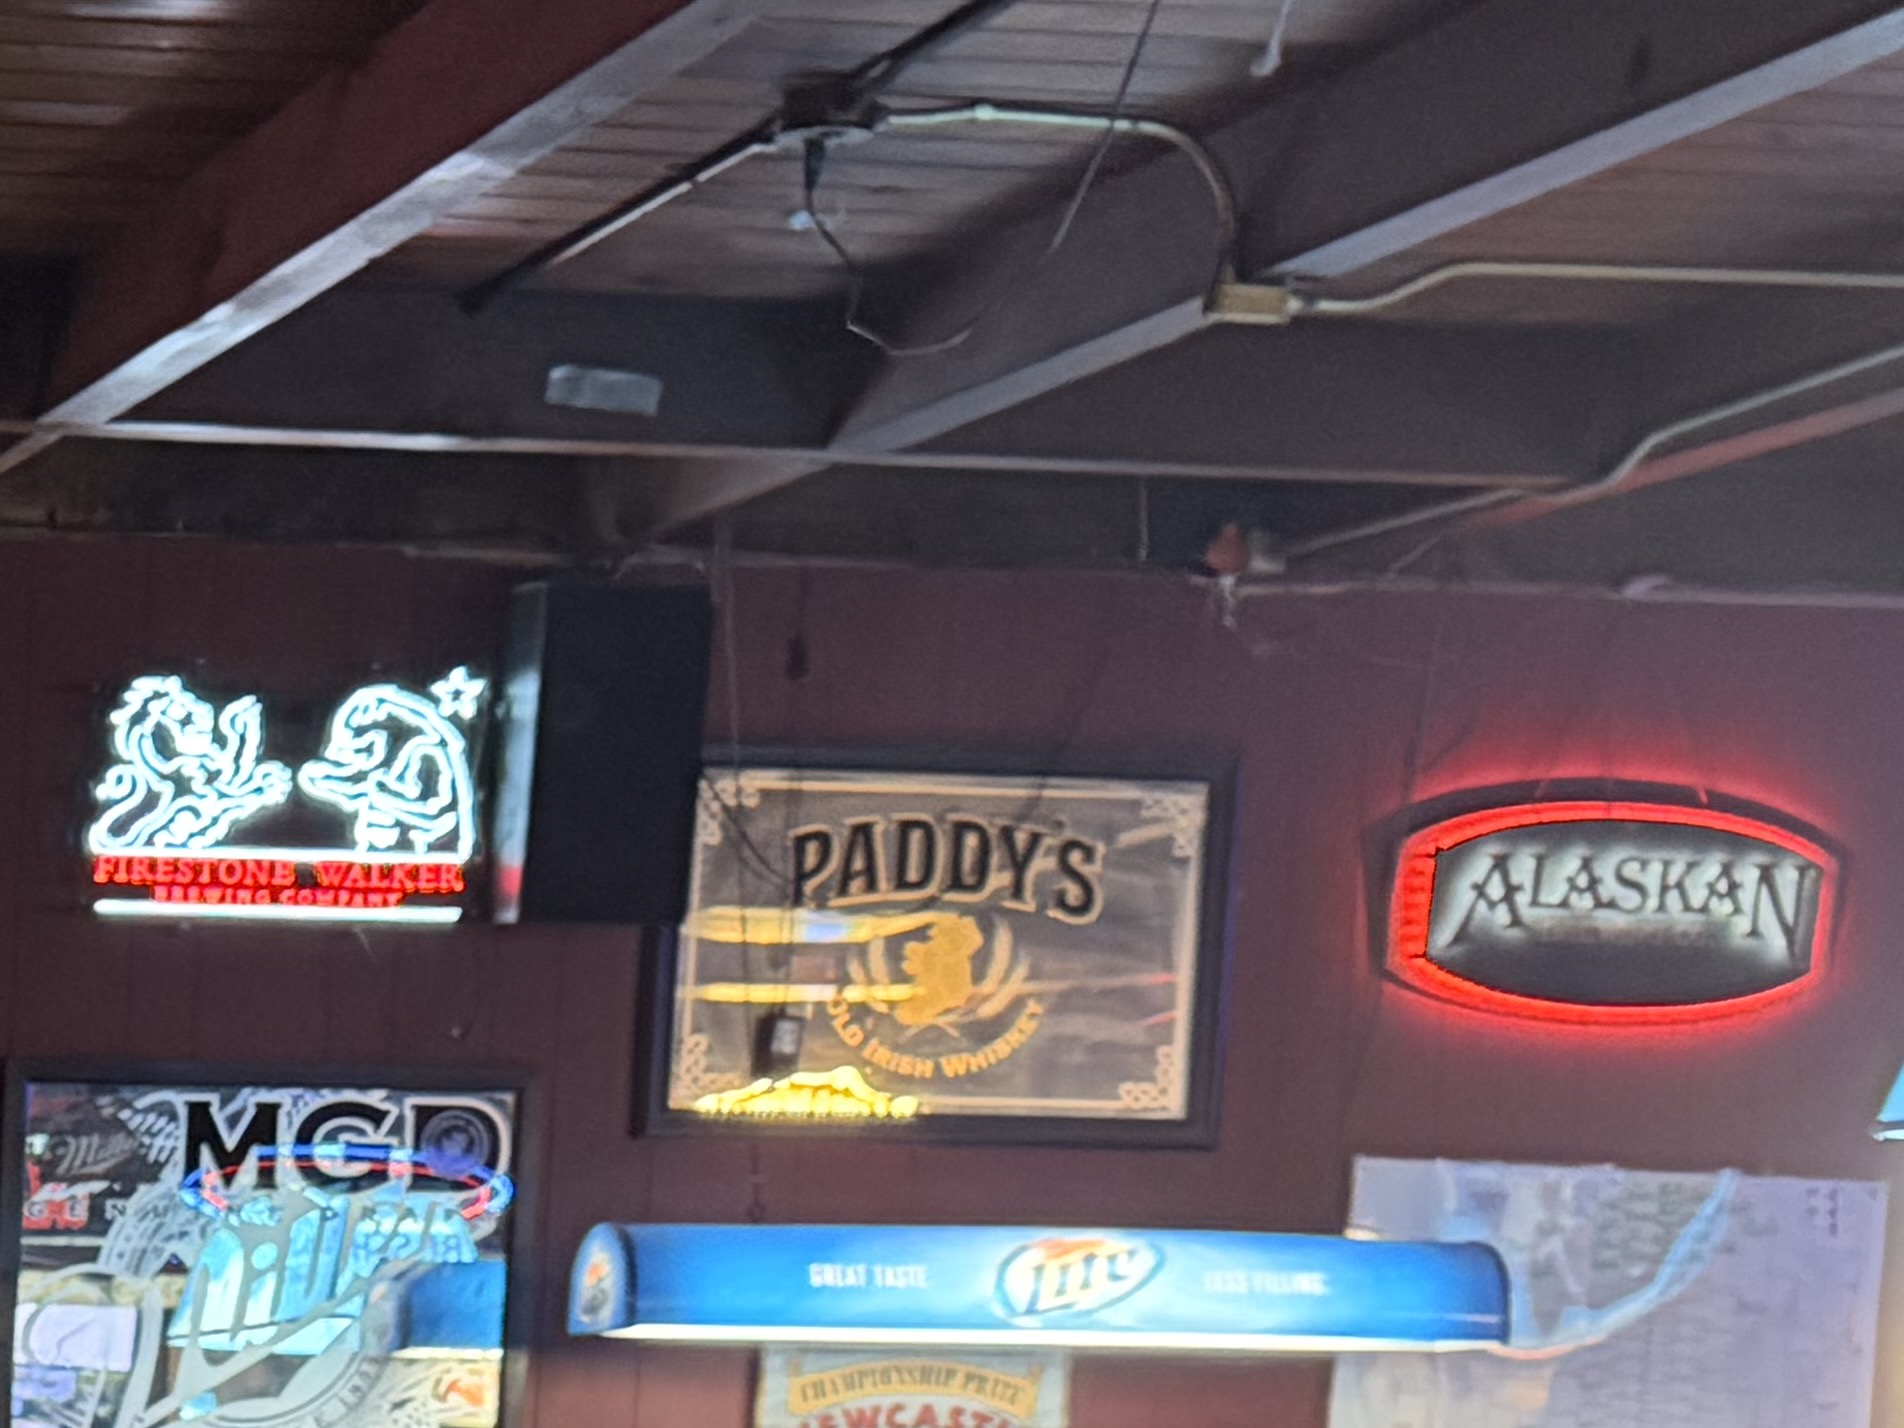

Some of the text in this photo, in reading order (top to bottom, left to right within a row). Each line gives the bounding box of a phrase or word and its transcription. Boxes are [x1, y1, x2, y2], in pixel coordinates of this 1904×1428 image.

[94, 855, 466, 893] FIRESTONE WALKER
[790, 812, 1108, 926] PADDY'S
[1445, 851, 1824, 966] ALASKAN
[826, 988, 866, 1048] OLD
[862, 1038, 935, 1080] IRISH
[187, 1093, 508, 1198] MGD
[809, 1263, 867, 1288] GREAT
